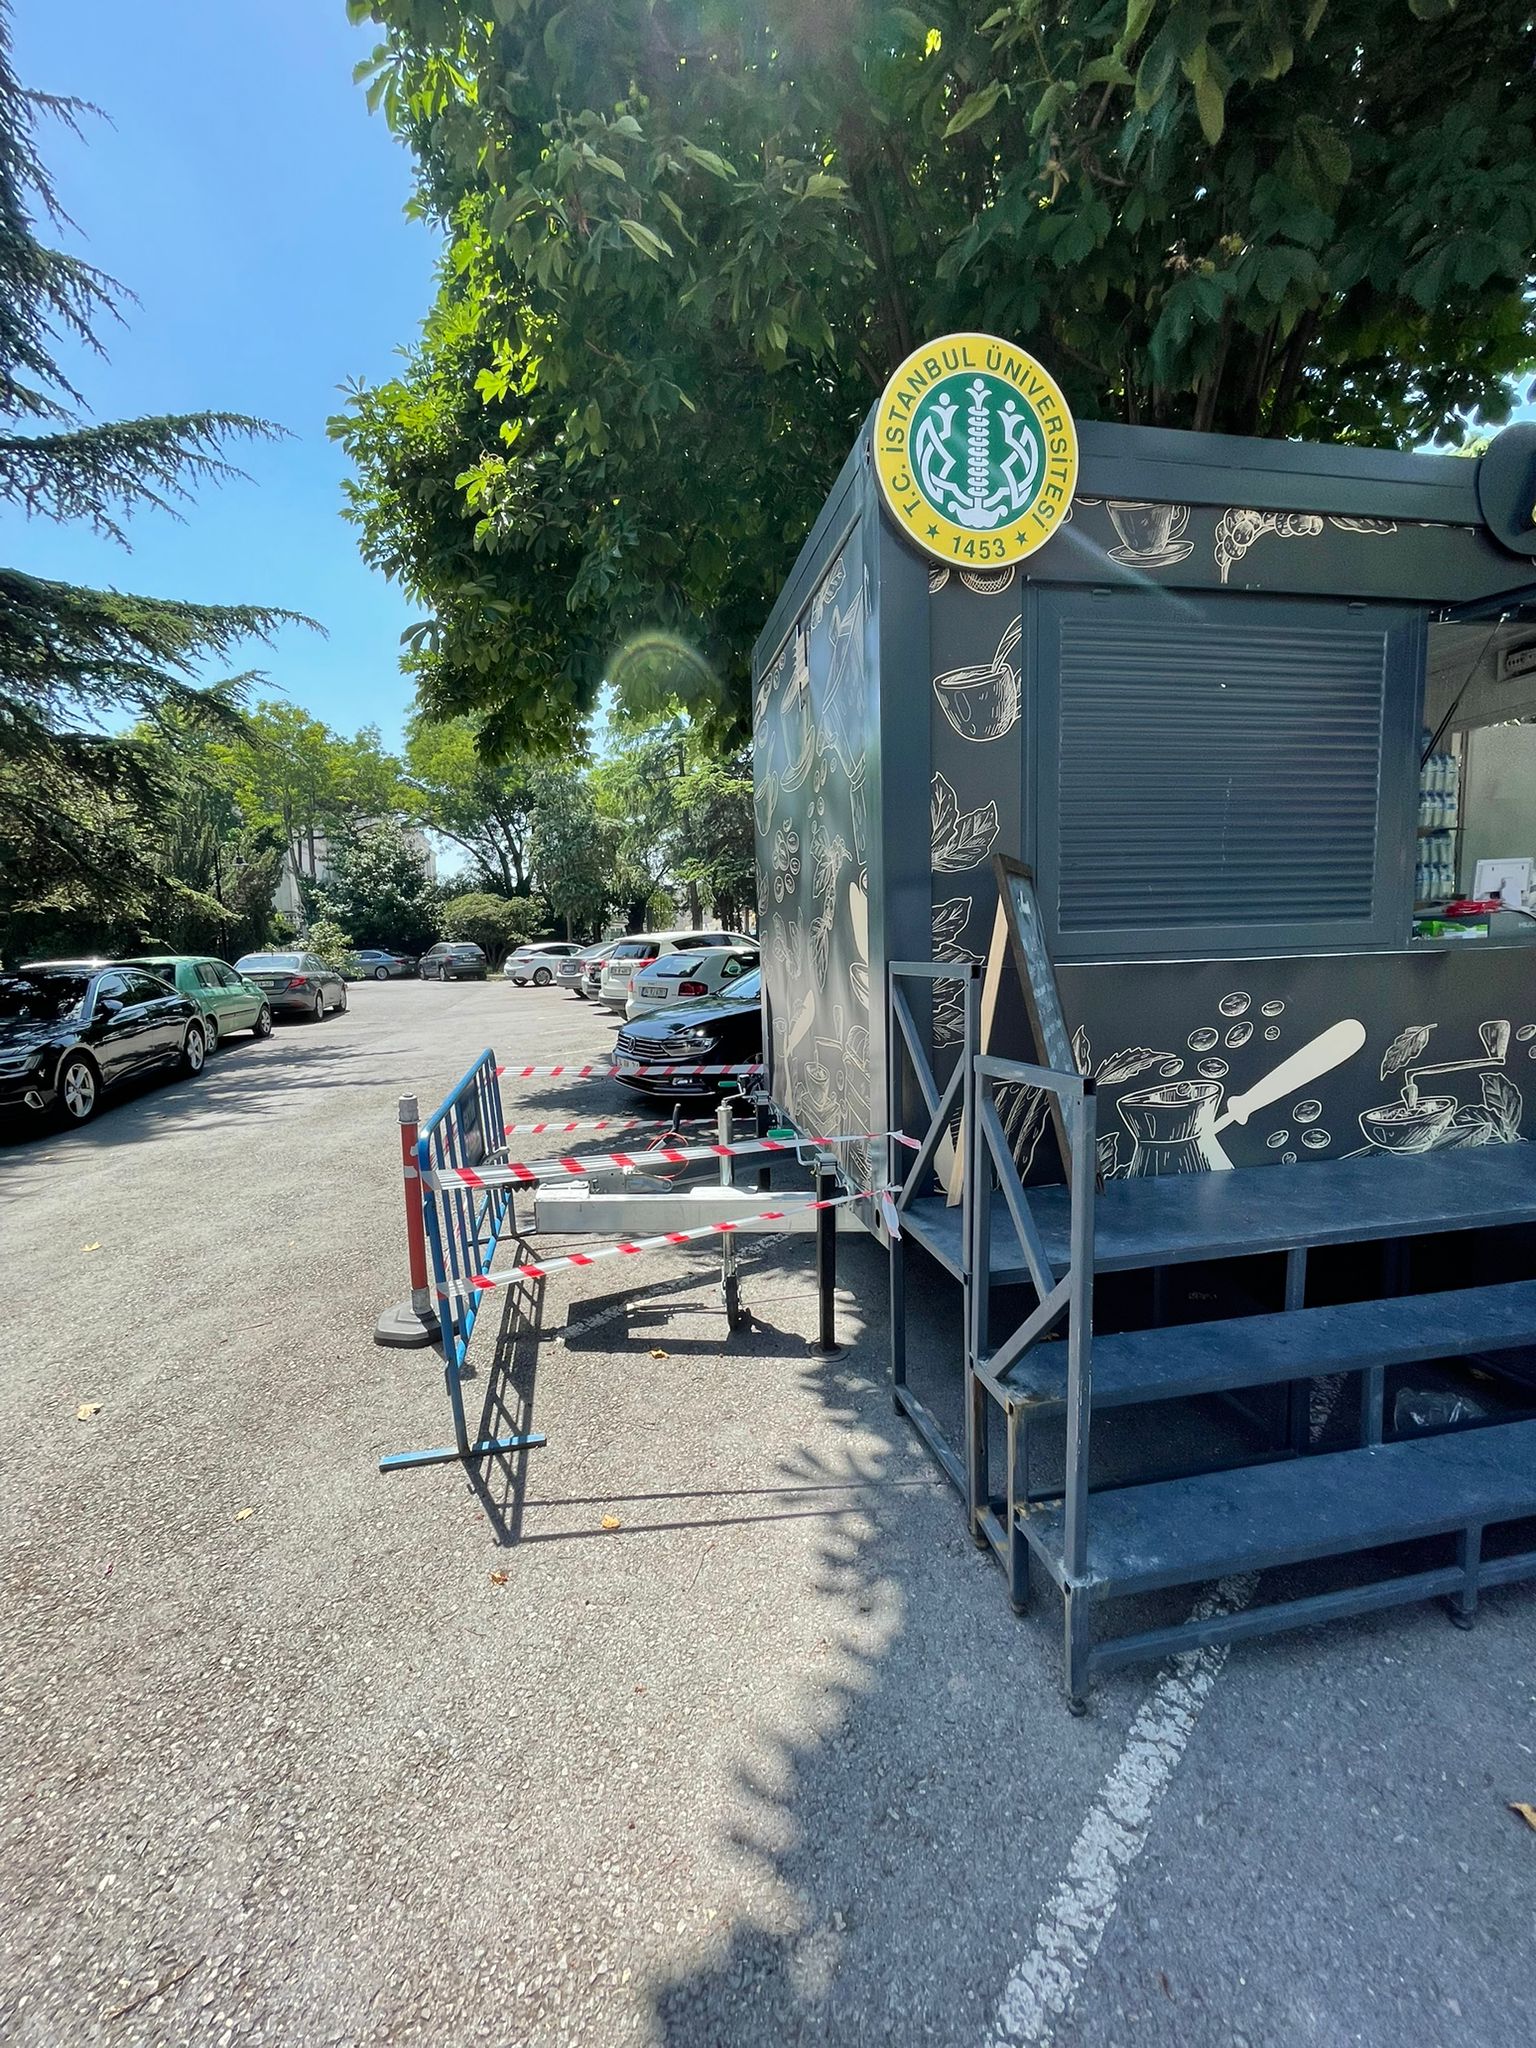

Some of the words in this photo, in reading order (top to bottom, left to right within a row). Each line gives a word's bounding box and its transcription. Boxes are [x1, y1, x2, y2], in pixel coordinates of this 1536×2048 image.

[881, 346, 976, 453] İSTANBUL
[986, 344, 1073, 532] ÜNİVERSİTESİ
[892, 463, 921, 518] T.C.
[952, 535, 1006, 560] 1453
